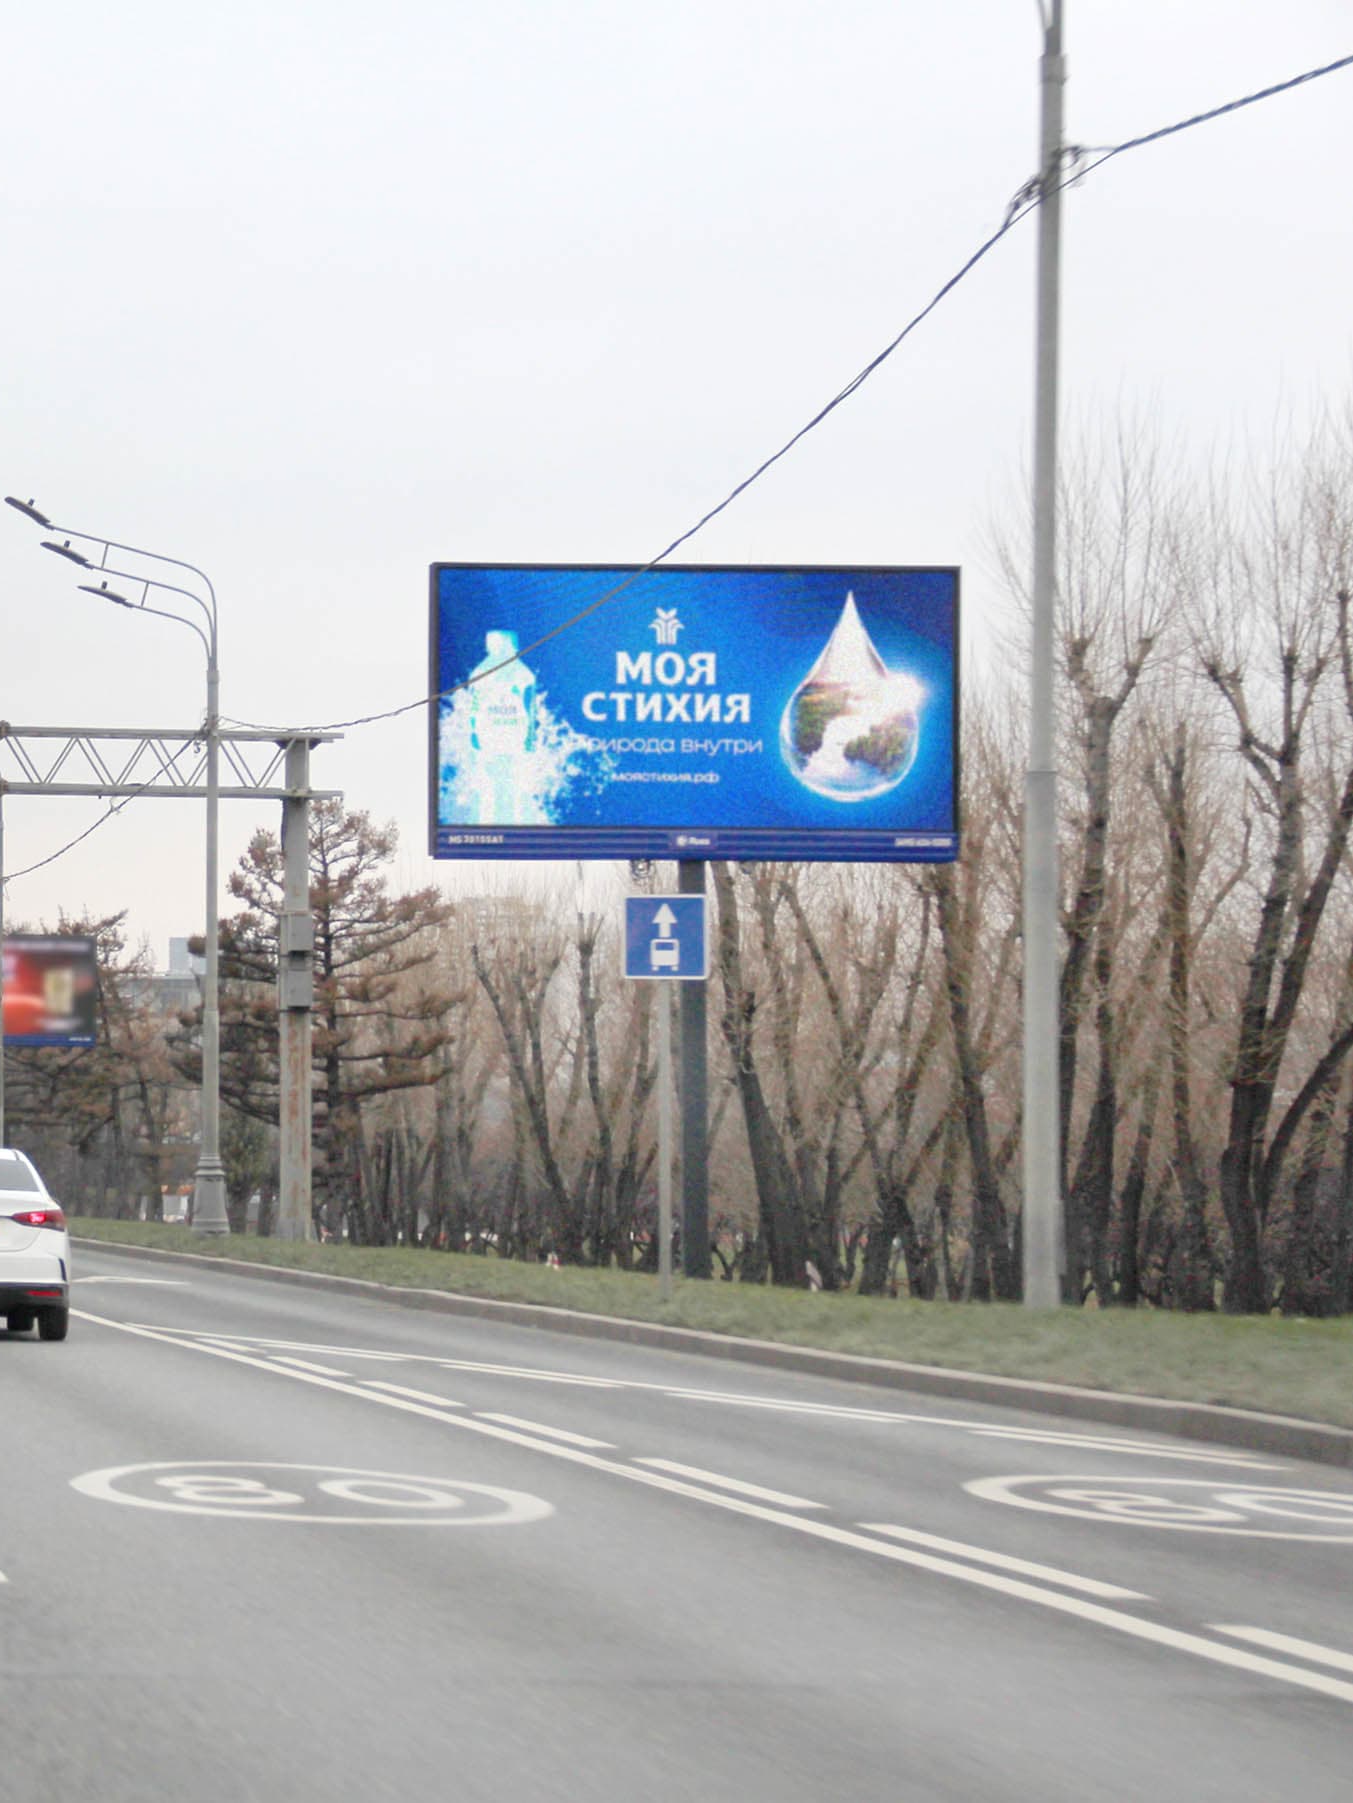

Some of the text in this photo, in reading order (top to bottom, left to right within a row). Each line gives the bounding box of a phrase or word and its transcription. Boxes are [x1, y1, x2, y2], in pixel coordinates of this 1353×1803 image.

[615, 651, 716, 686] МОЯ
[581, 691, 750, 723] СТИХИЯ
[681, 738, 763, 756] внутри
[154, 1475, 465, 1509] 80
